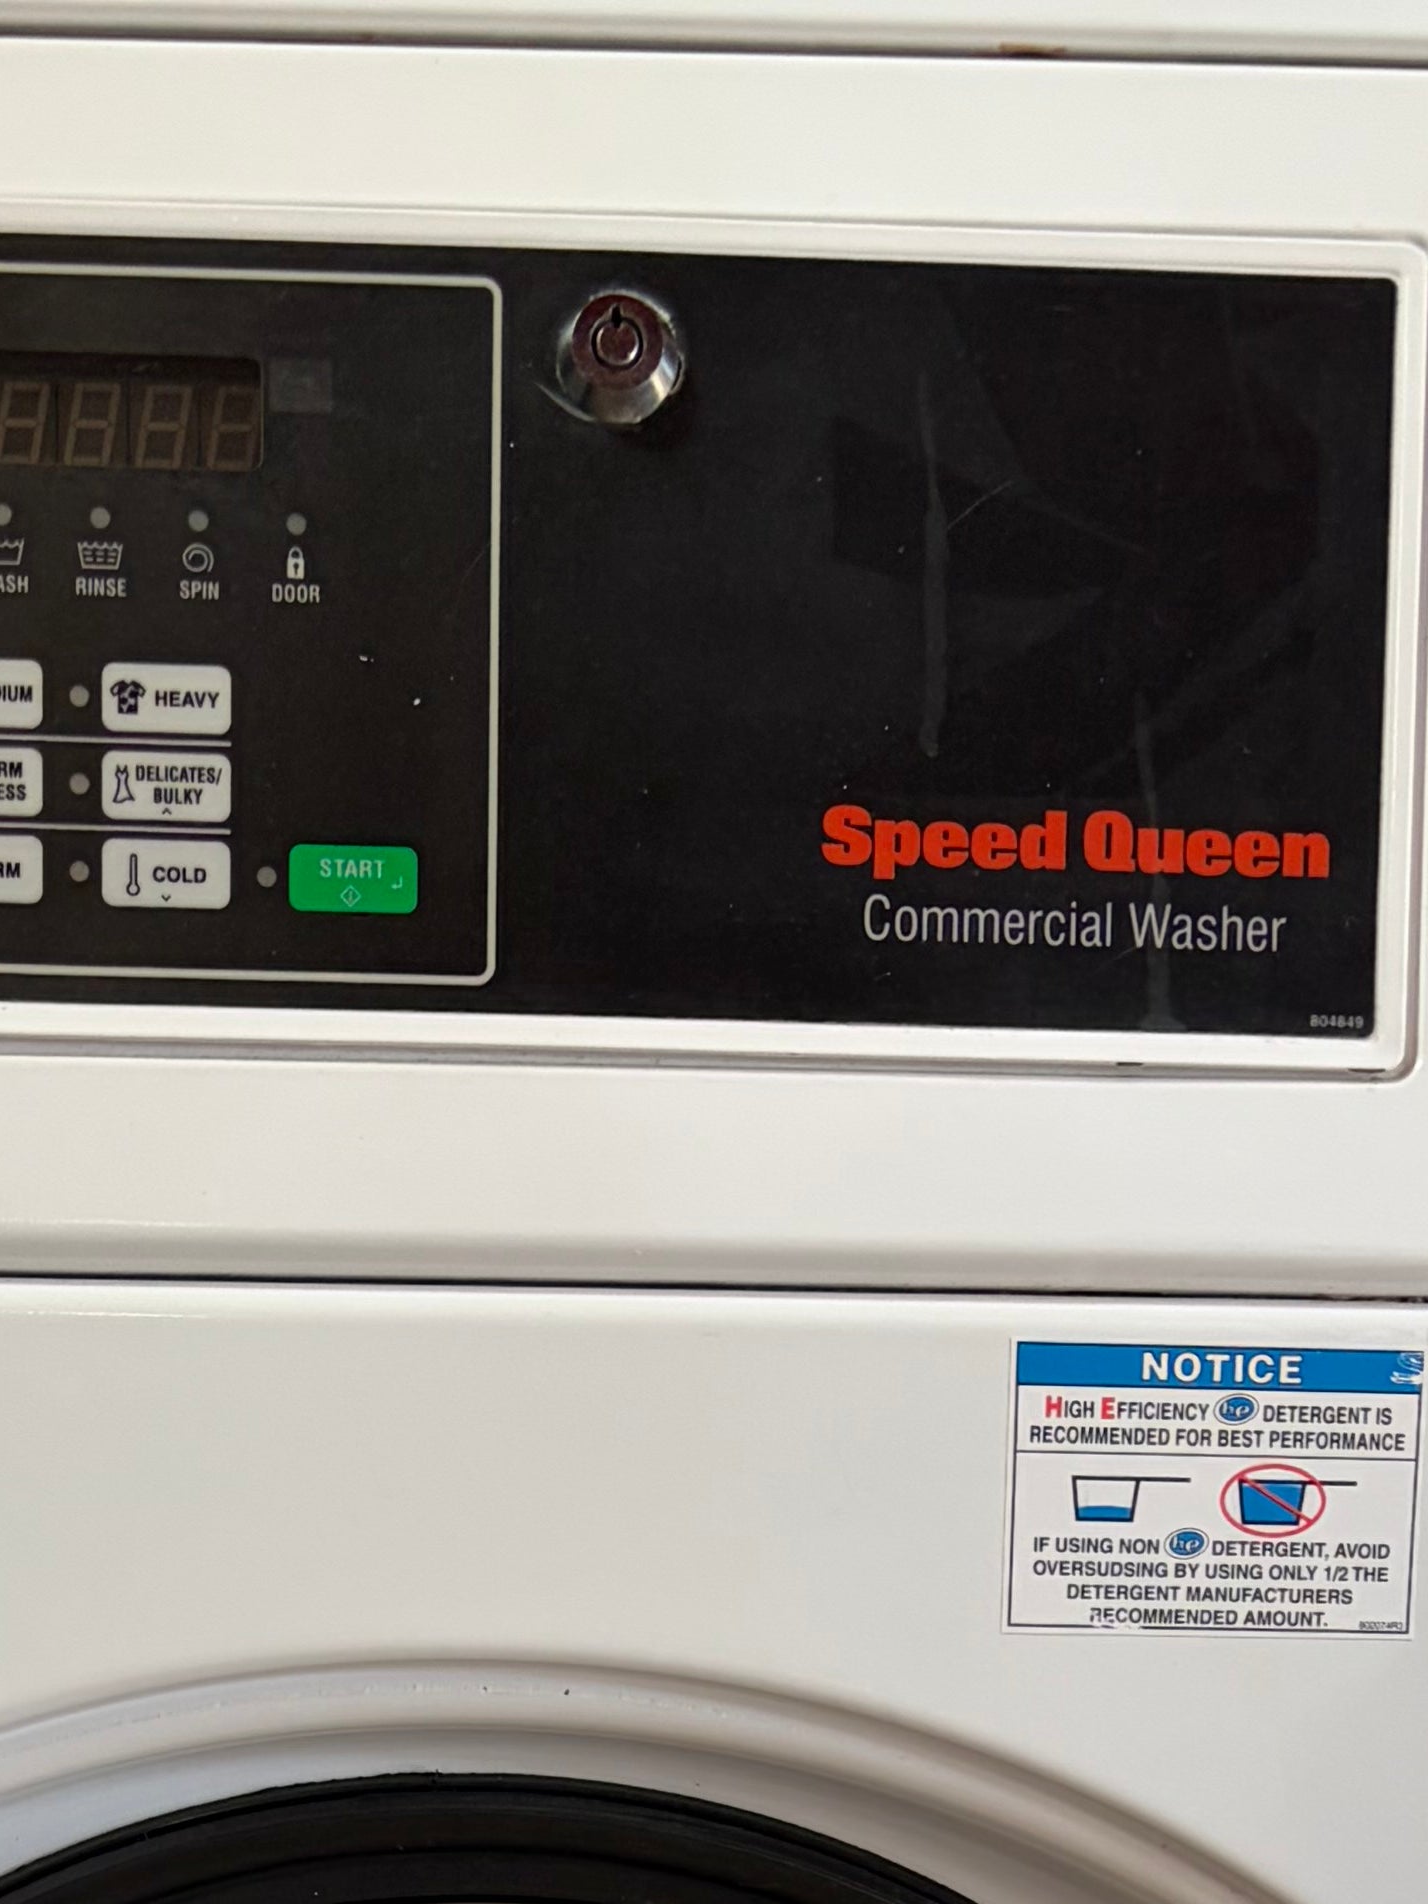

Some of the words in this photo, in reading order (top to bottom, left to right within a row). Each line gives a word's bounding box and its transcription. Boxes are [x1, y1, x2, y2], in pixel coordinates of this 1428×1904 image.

[76, 577, 125, 596] RINSE
[180, 580, 219, 599] SPIN
[272, 584, 319, 603] DOOR
[155, 690, 219, 708] HEAVY
[136, 765, 222, 784] DELICATES/
[154, 787, 202, 804] BULKY
[822, 805, 1067, 879] Speed
[1084, 810, 1330, 878] Queen
[153, 866, 206, 883] COLD
[320, 859, 382, 878] START
[864, 894, 1112, 947] Commercial
[1129, 903, 1286, 952] Washer
[1143, 1353, 1301, 1383] NOTICE
[1046, 1396, 1094, 1418] HIGH
[1102, 1397, 1209, 1421] EFFICIENCY
[1263, 1405, 1371, 1424] DETERGENT
[1376, 1408, 1392, 1425] IS
[1030, 1425, 1170, 1445] RECOMMENDED
[1176, 1429, 1212, 1446] FOR
[1218, 1430, 1264, 1448] BEST
[1270, 1431, 1405, 1451] PERFORMANCE
[1034, 1537, 1050, 1552] IF
[1056, 1538, 1113, 1554] USING
[1119, 1539, 1159, 1554] NON
[1212, 1541, 1329, 1558] DETERGENT,
[1334, 1543, 1390, 1559] AVOID
[1033, 1560, 1168, 1578] OVERSUDSING
[1174, 1563, 1199, 1578] BY
[1206, 1564, 1262, 1580] USING
[1269, 1565, 1317, 1580] ONLY
[1324, 1566, 1348, 1582] 1/2
[1352, 1567, 1388, 1582] THE
[1067, 1584, 1180, 1601] DETERGENT
[1186, 1586, 1352, 1604] MANUFACTURERS
[1090, 1608, 1237, 1625] RECOMMENDED
[1244, 1611, 1327, 1626] AMOUNT.
